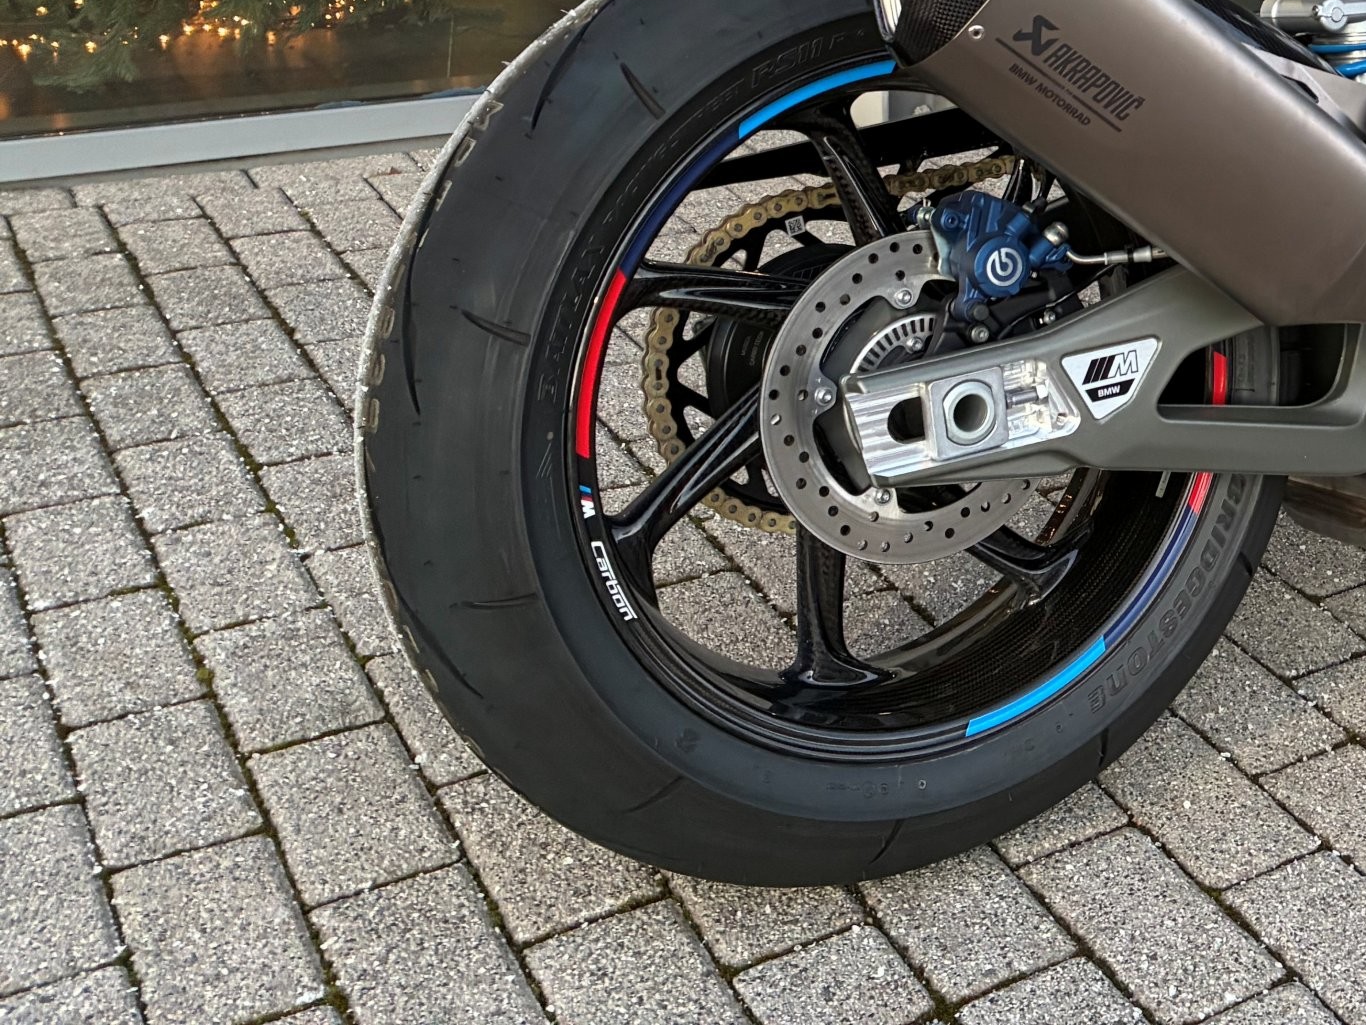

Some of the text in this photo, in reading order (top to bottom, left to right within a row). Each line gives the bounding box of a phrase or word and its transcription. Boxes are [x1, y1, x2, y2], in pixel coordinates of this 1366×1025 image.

[1008, 64, 1092, 126] BMW MOTORRAD
[1097, 384, 1121, 398] BMW
[1087, 474, 1248, 715] BRIDGESTONE
